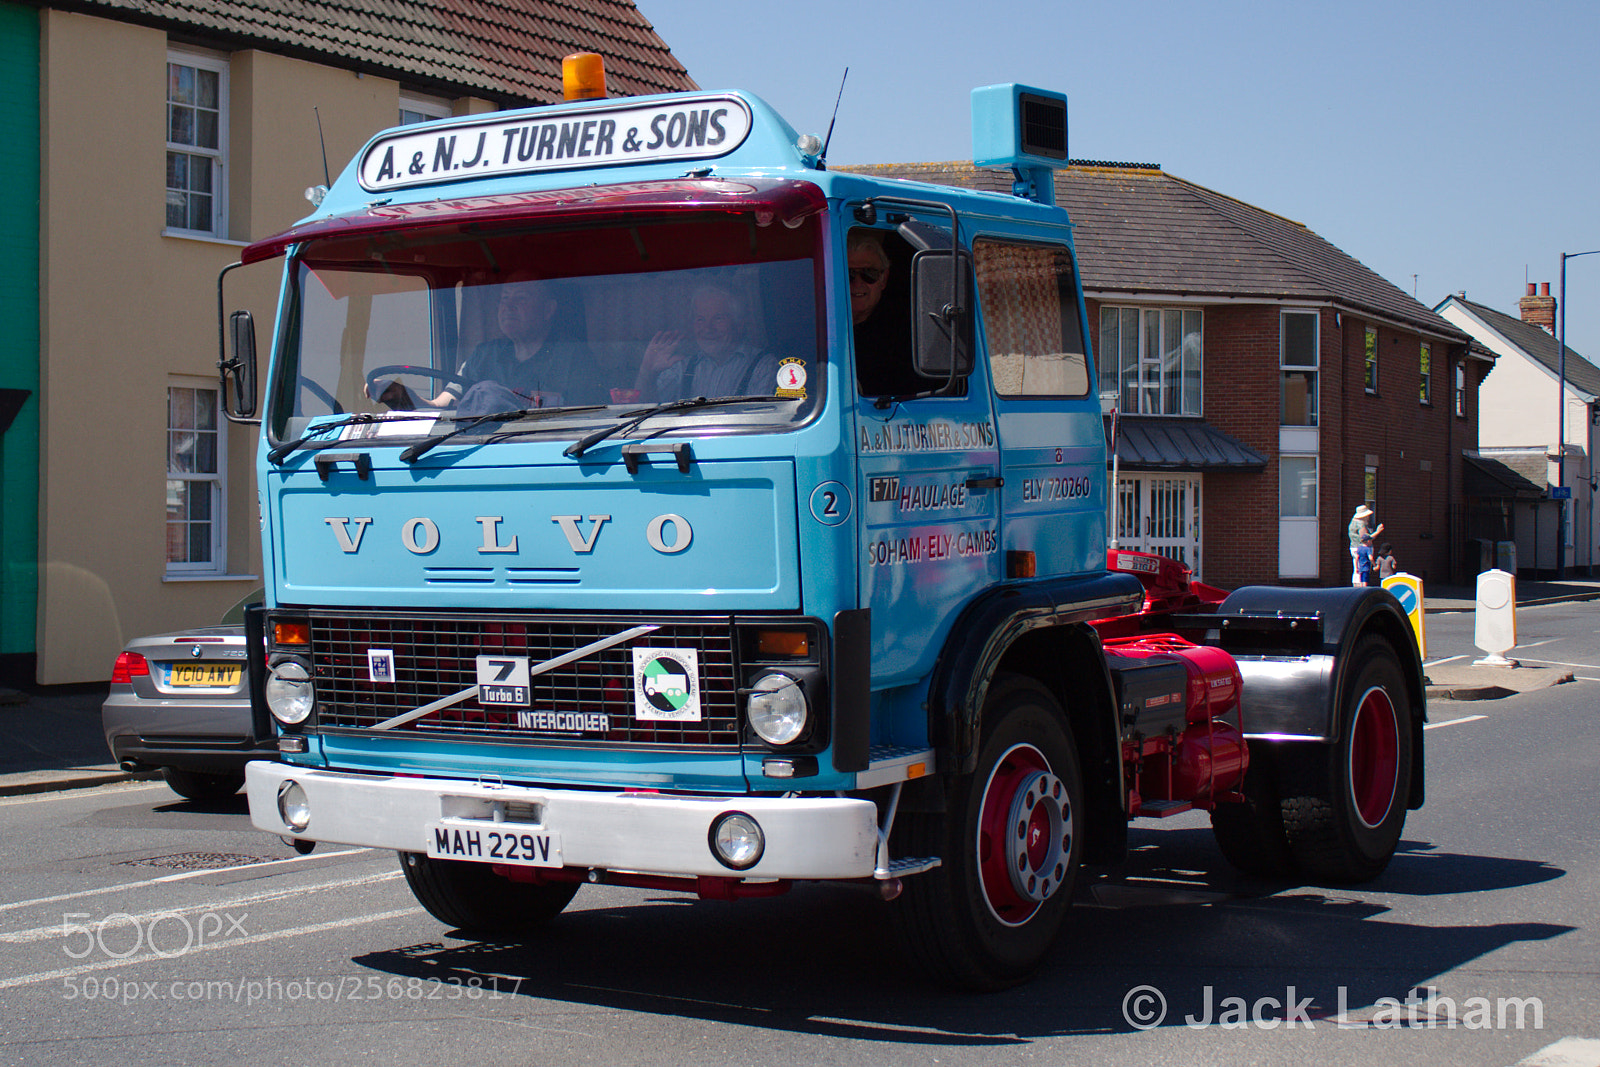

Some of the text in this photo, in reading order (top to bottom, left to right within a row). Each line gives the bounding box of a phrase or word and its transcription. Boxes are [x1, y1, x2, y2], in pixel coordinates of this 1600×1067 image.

[376, 108, 728, 181] A. & N.J. TURNER & SONS
[903, 422, 953, 449] TURNER
[963, 421, 994, 447] SONS
[882, 478, 900, 500] 717
[900, 482, 966, 512] HAULAGE
[1022, 476, 1091, 502] ELY 720260
[823, 491, 840, 516] 2
[324, 513, 694, 554] VOLVO
[868, 529, 998, 566] SOHAM ELY CAMBS
[175, 666, 204, 682] YC10
[488, 660, 516, 681] 7
[483, 685, 524, 703] Turbo 6
[517, 711, 610, 731] INTERCOOLER
[434, 827, 550, 862] MAH 229V
